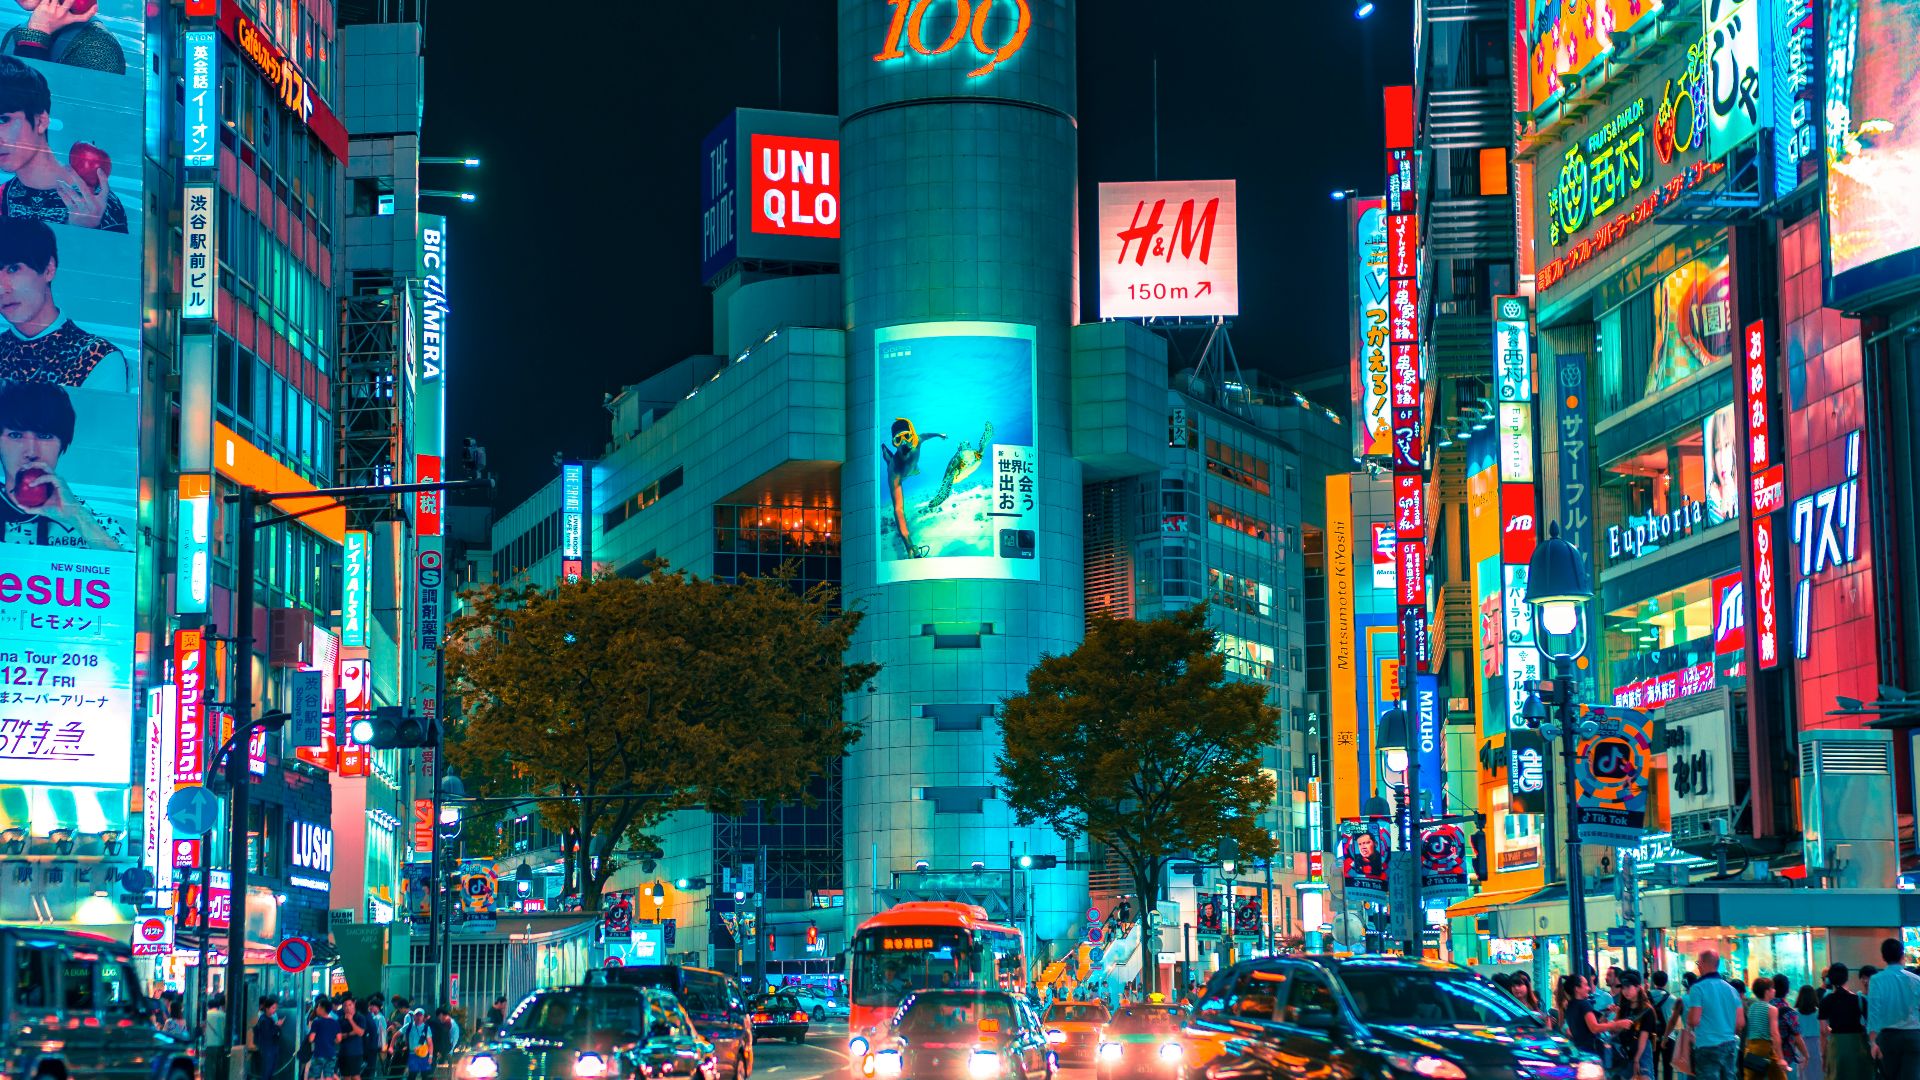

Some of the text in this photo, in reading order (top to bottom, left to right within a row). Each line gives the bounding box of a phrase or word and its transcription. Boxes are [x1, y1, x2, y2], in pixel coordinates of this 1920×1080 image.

[873, 0, 1031, 77] 109
[192, 46, 208, 153] 英会話イーオン
[281, 59, 313, 124] ガスト
[192, 157, 207, 167] 6F
[710, 138, 728, 200] THE
[763, 148, 830, 186] UNI
[704, 189, 734, 263] PRIME
[763, 188, 837, 228] QLO
[189, 195, 207, 307] 渋谷駅前ビル
[1117, 198, 1220, 267] H&M
[423, 229, 450, 379] BIC CAMERA
[1128, 283, 1189, 300] 150m
[1503, 325, 1524, 383] 渋谷西村
[1400, 410, 1413, 419] 6F
[1510, 408, 1521, 469] Euphoria
[566, 467, 579, 511] THE PRIME
[998, 459, 1034, 474] 世界に
[1402, 478, 1414, 487] 6F
[1505, 515, 1533, 533] JTB
[1608, 494, 1702, 559] Euphoria
[51, 563, 110, 574] NEW SINGLE
[344, 537, 361, 632] レイクALSA
[419, 551, 442, 587] OS
[421, 589, 439, 650] 調剤薬局
[1336, 582, 1352, 670] Matsumoto
[1, 666, 75, 688] 12.7 FRI
[25, 650, 58, 665] Tour
[62, 653, 98, 667] 2018
[305, 676, 319, 741] 渋谷駅前
[1513, 670, 1524, 711] フルーツ
[179, 672, 199, 773] サンドラッグ
[1337, 731, 1353, 746] 薬
[1419, 690, 1434, 753] MIZUHO
[1518, 748, 1543, 793] HUB
[1592, 814, 1628, 826] Tik Tok
[292, 820, 332, 872] LUSH
[144, 927, 164, 936] ガスト
